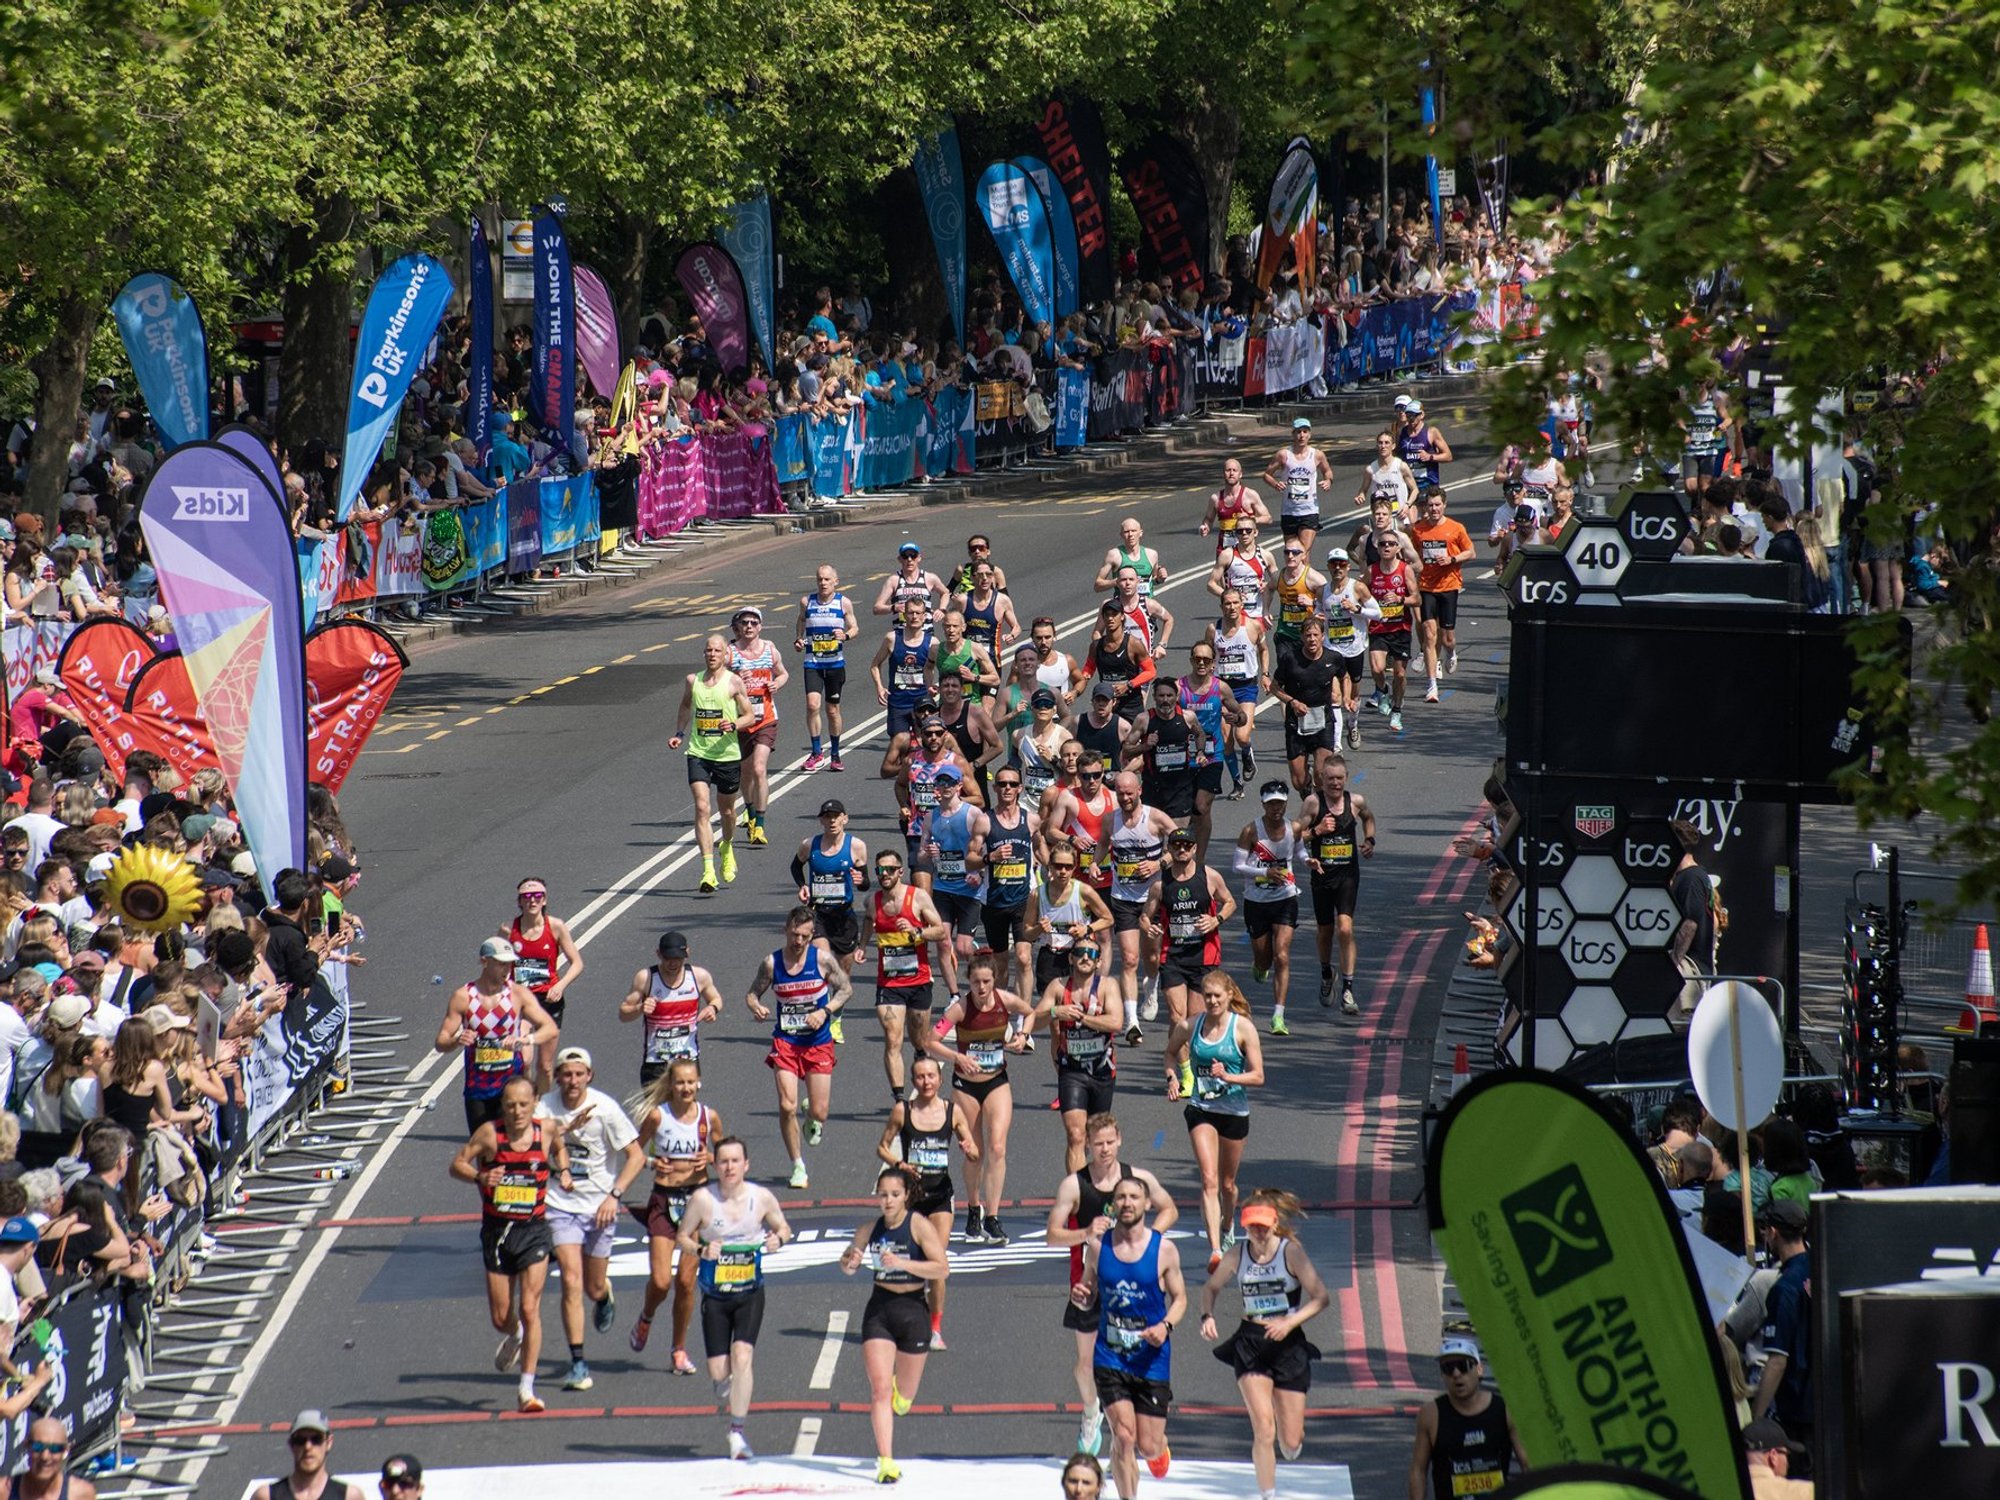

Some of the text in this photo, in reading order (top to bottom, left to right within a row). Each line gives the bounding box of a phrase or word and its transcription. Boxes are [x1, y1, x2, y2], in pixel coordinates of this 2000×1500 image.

[1035, 101, 1107, 258] SHELTER
[547, 253, 562, 346] JOIN THE
[372, 263, 430, 371] Parkinson's
[143, 322, 163, 353] UK
[385, 344, 408, 377] UK
[159, 316, 198, 435] Parkinson's
[1630, 510, 1678, 541] tcs
[1576, 542, 1620, 570] 40
[1521, 575, 1568, 604] tcs
[76, 656, 121, 725] RUTH
[146, 689, 206, 762] RUTH
[316, 651, 388, 775] STRAUSS
[1577, 818, 1615, 836] HEUER
[1578, 808, 1613, 819] TAG
[1518, 837, 1564, 867] tcs
[1624, 837, 1671, 868] tcs
[1172, 901, 1198, 911] ARMY
[1518, 902, 1564, 931] tcs
[1624, 902, 1671, 931] tcs
[1571, 935, 1616, 964] tcs
[777, 980, 817, 992] NEWBURY
[1071, 1042, 1098, 1052] 79134
[504, 1190, 527, 1201] 3011
[1247, 1265, 1277, 1276] BECKY
[1253, 1298, 1278, 1310] 1852
[1471, 1210, 1506, 1290] Saving
[1504, 1286, 1524, 1338] lives
[1524, 1343, 1565, 1425] through
[1553, 1303, 1650, 1474] NOLA
[1464, 1476, 1493, 1492] 2536
